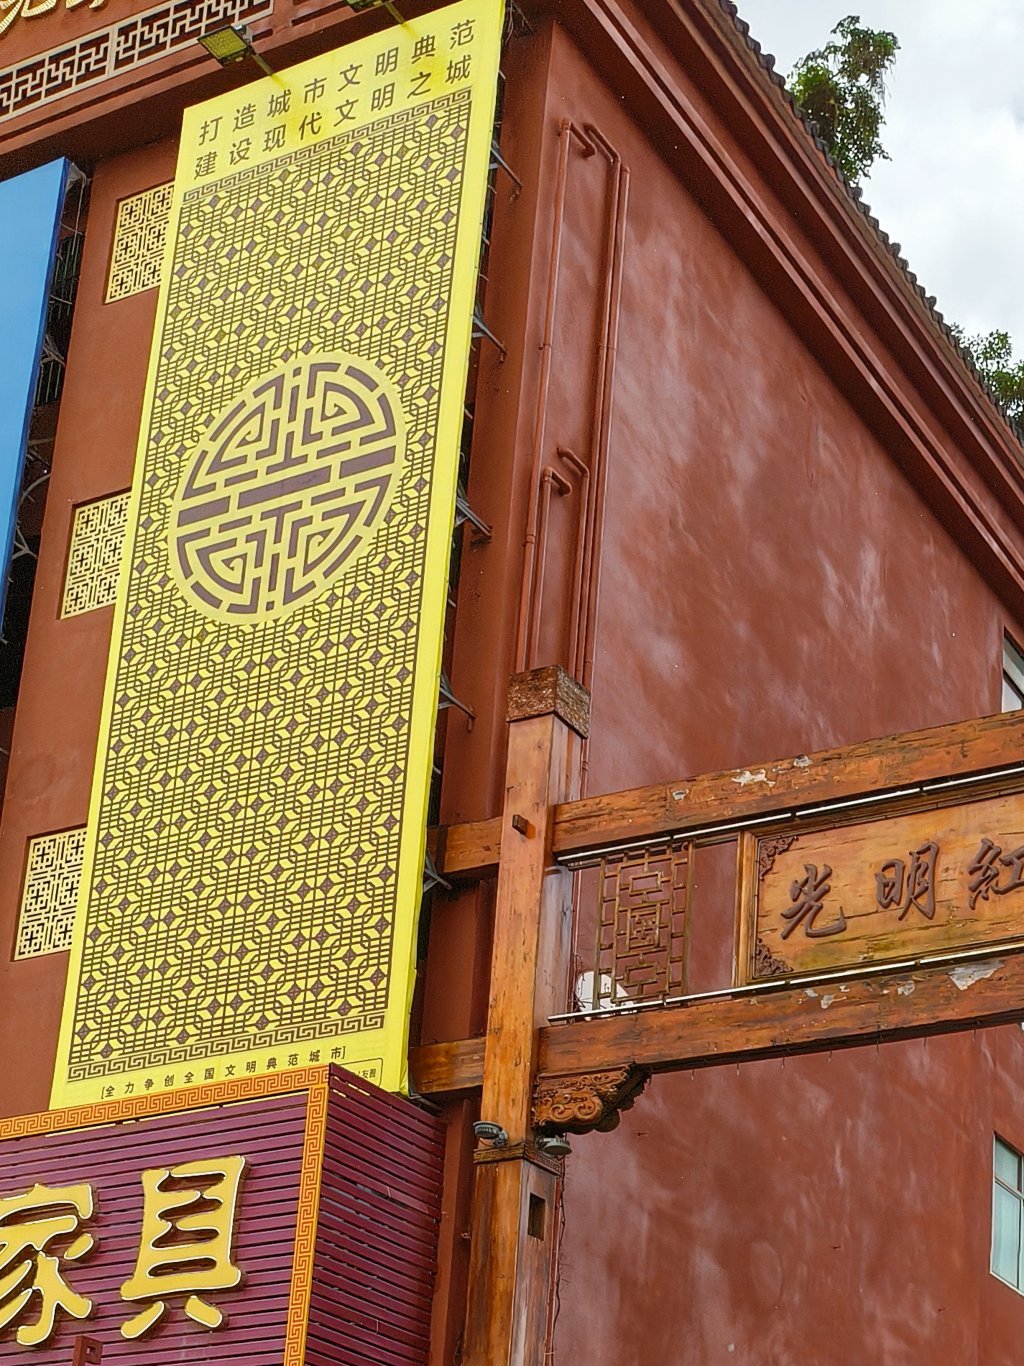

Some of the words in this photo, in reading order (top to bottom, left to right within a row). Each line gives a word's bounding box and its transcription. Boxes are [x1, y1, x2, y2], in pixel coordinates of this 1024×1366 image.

[193, 53, 471, 182] 建设现代文明之城
[199, 18, 475, 145] 打造城市文明典范
[0, 1155, 249, 1347] 家具
